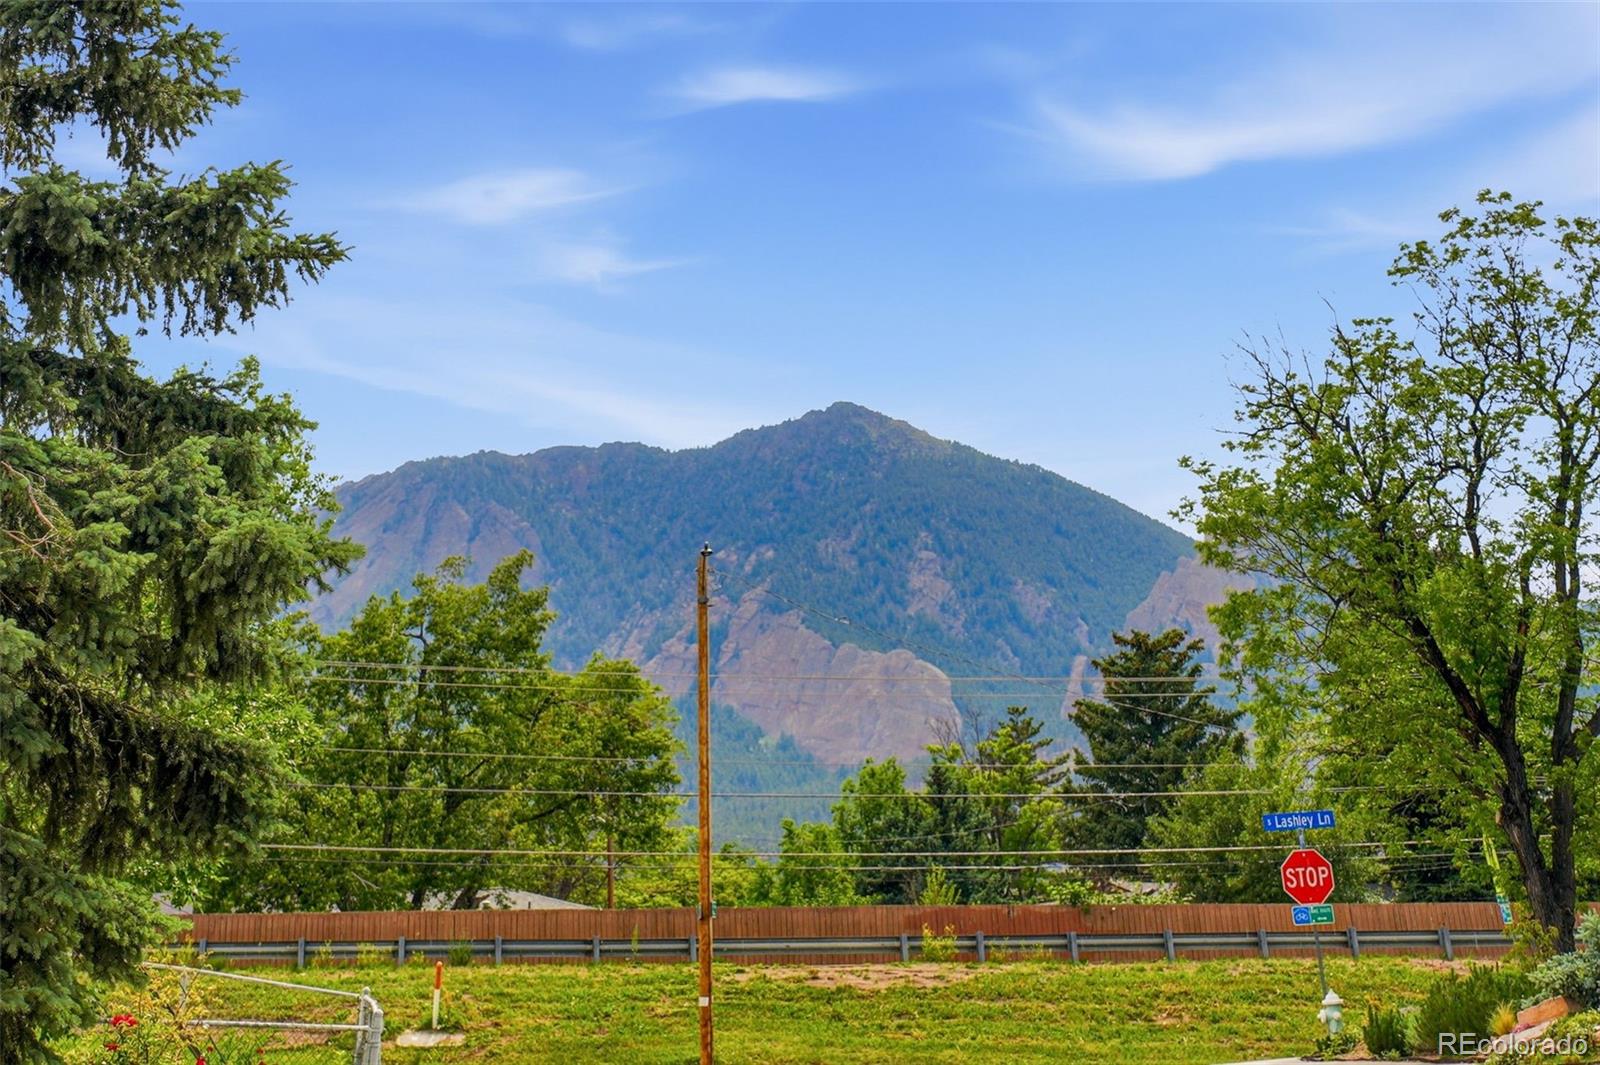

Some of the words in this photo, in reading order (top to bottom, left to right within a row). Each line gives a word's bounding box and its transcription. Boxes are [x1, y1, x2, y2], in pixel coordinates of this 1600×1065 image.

[1274, 815, 1312, 828] Lashley
[1317, 813, 1331, 825] Ln
[1285, 866, 1329, 888] STOP
